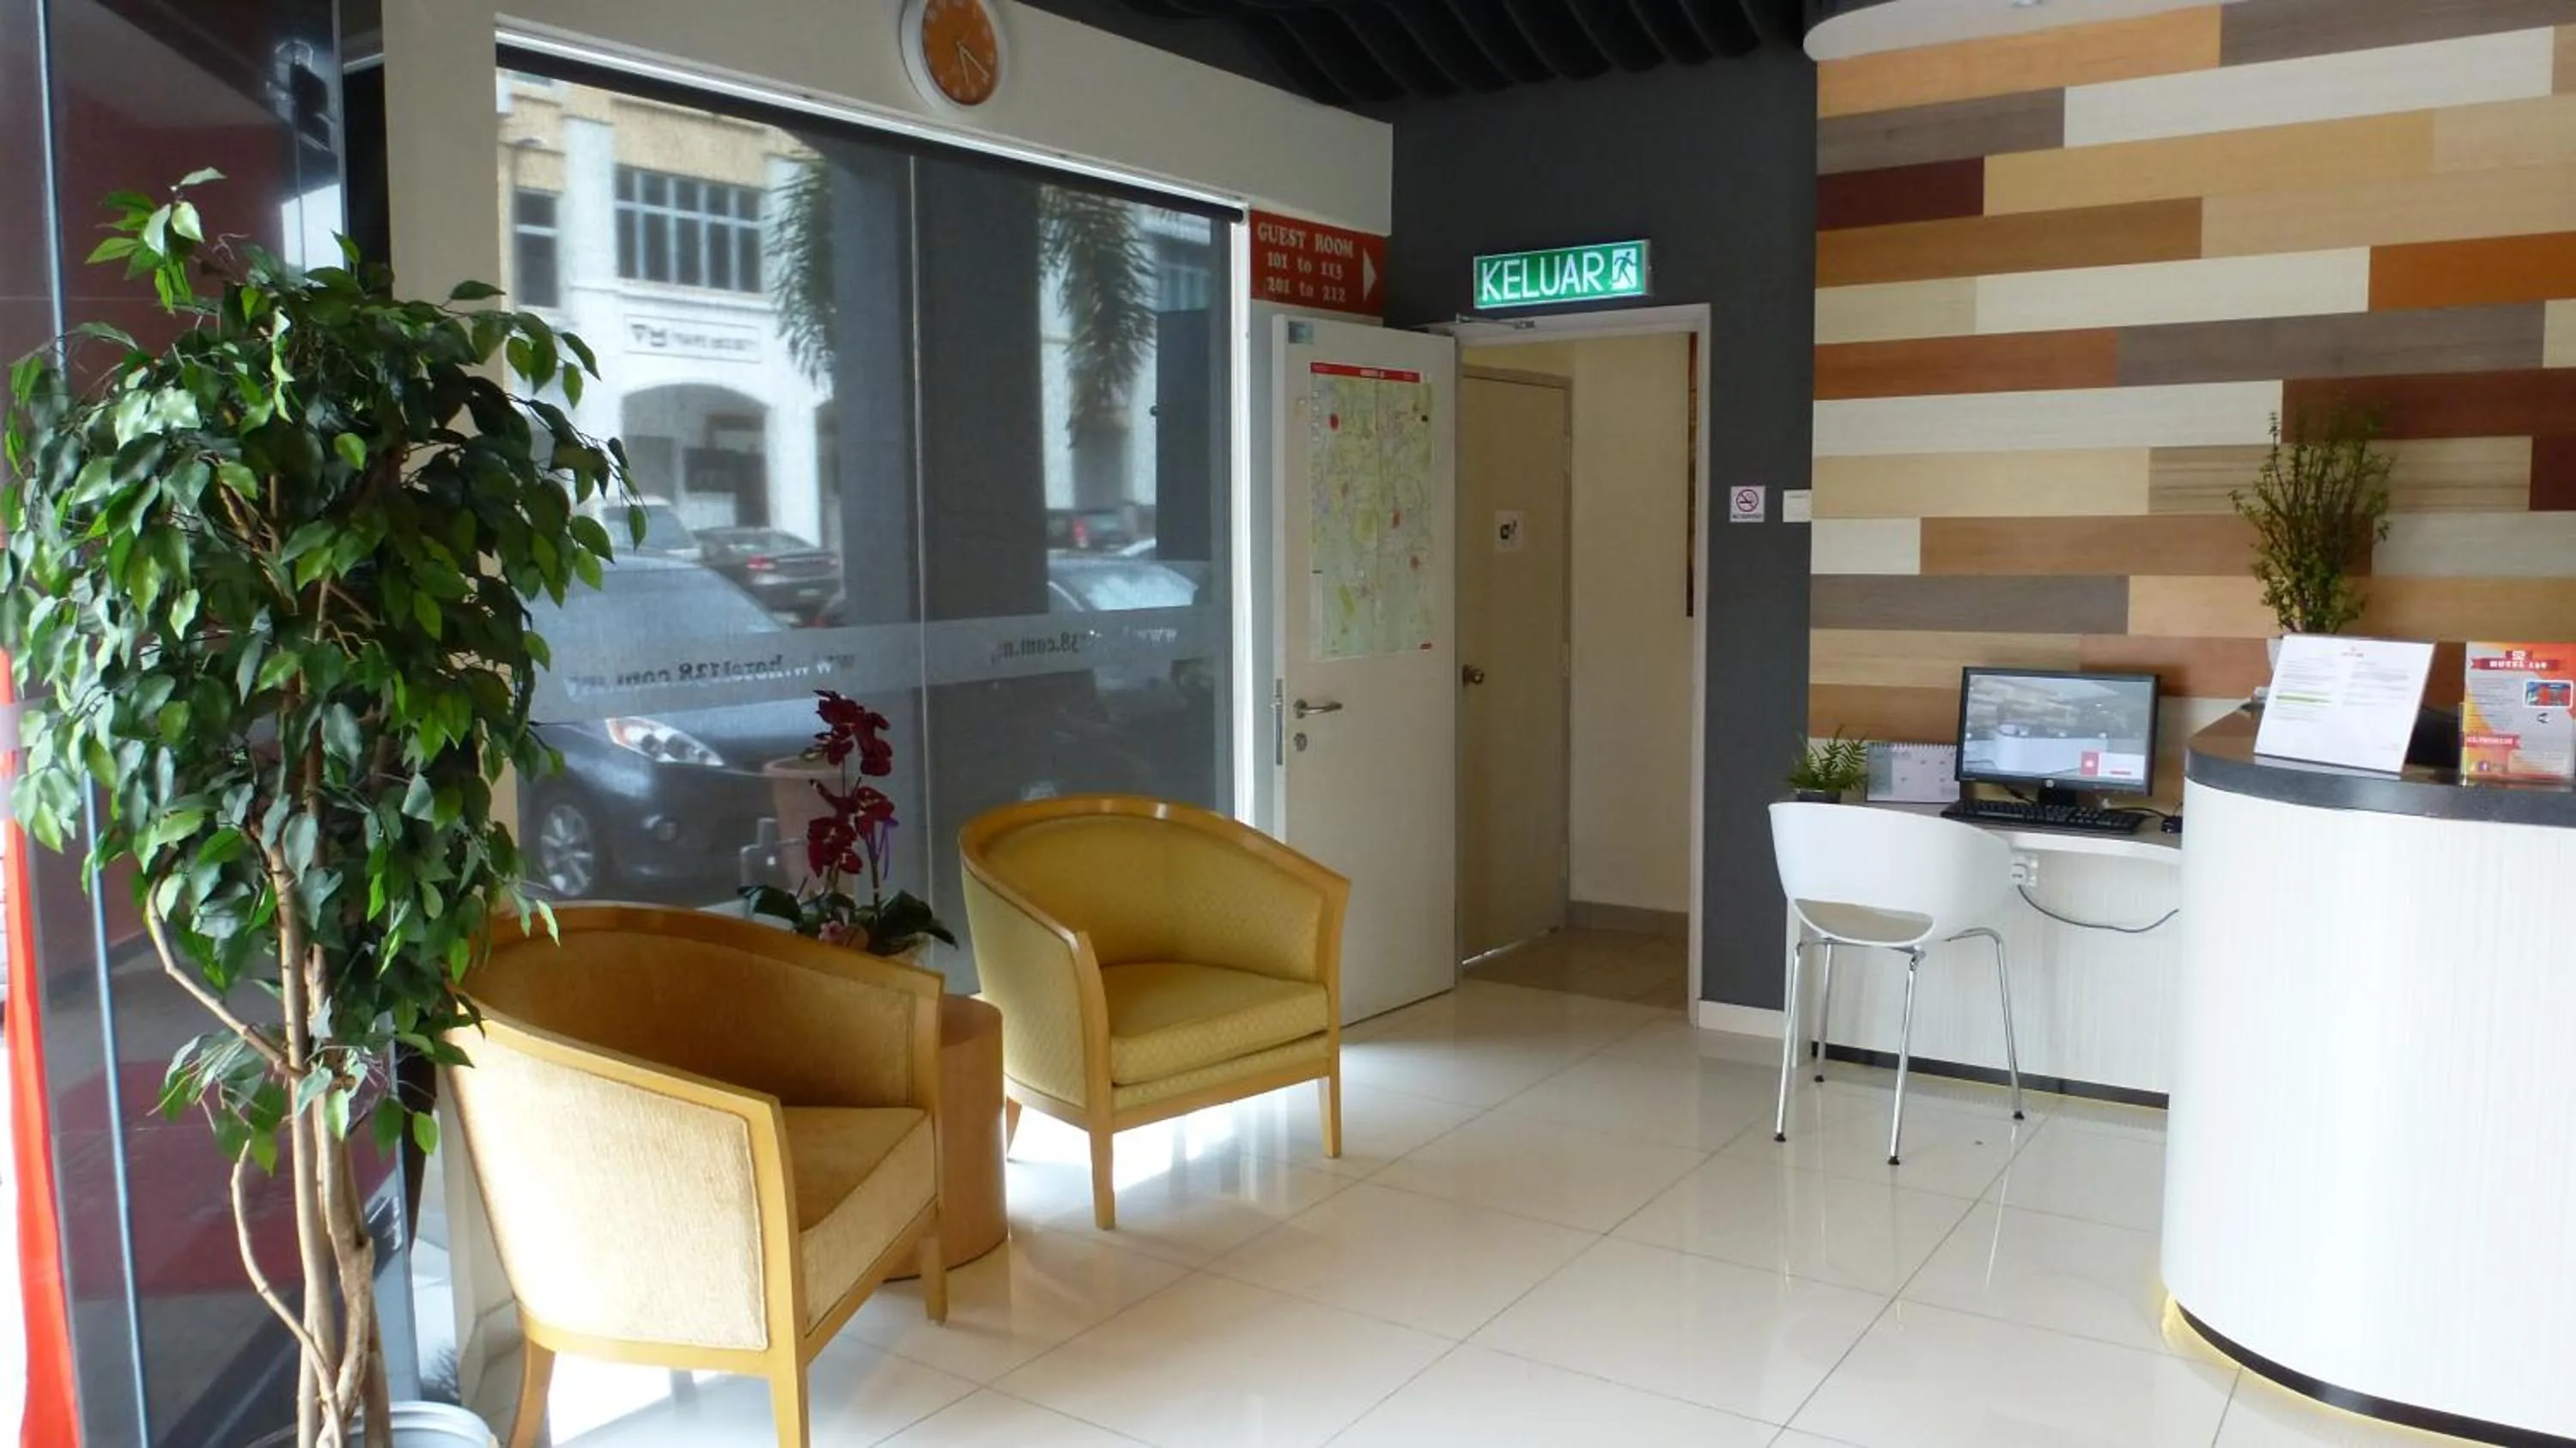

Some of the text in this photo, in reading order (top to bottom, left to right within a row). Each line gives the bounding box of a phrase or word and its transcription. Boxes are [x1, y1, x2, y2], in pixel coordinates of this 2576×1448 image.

[1257, 222, 1353, 259] GUEST ROOM
[1267, 251, 1344, 282] 101 to 113
[1481, 251, 1605, 301] KELUAR
[1266, 276, 1346, 303] 201 to 212
